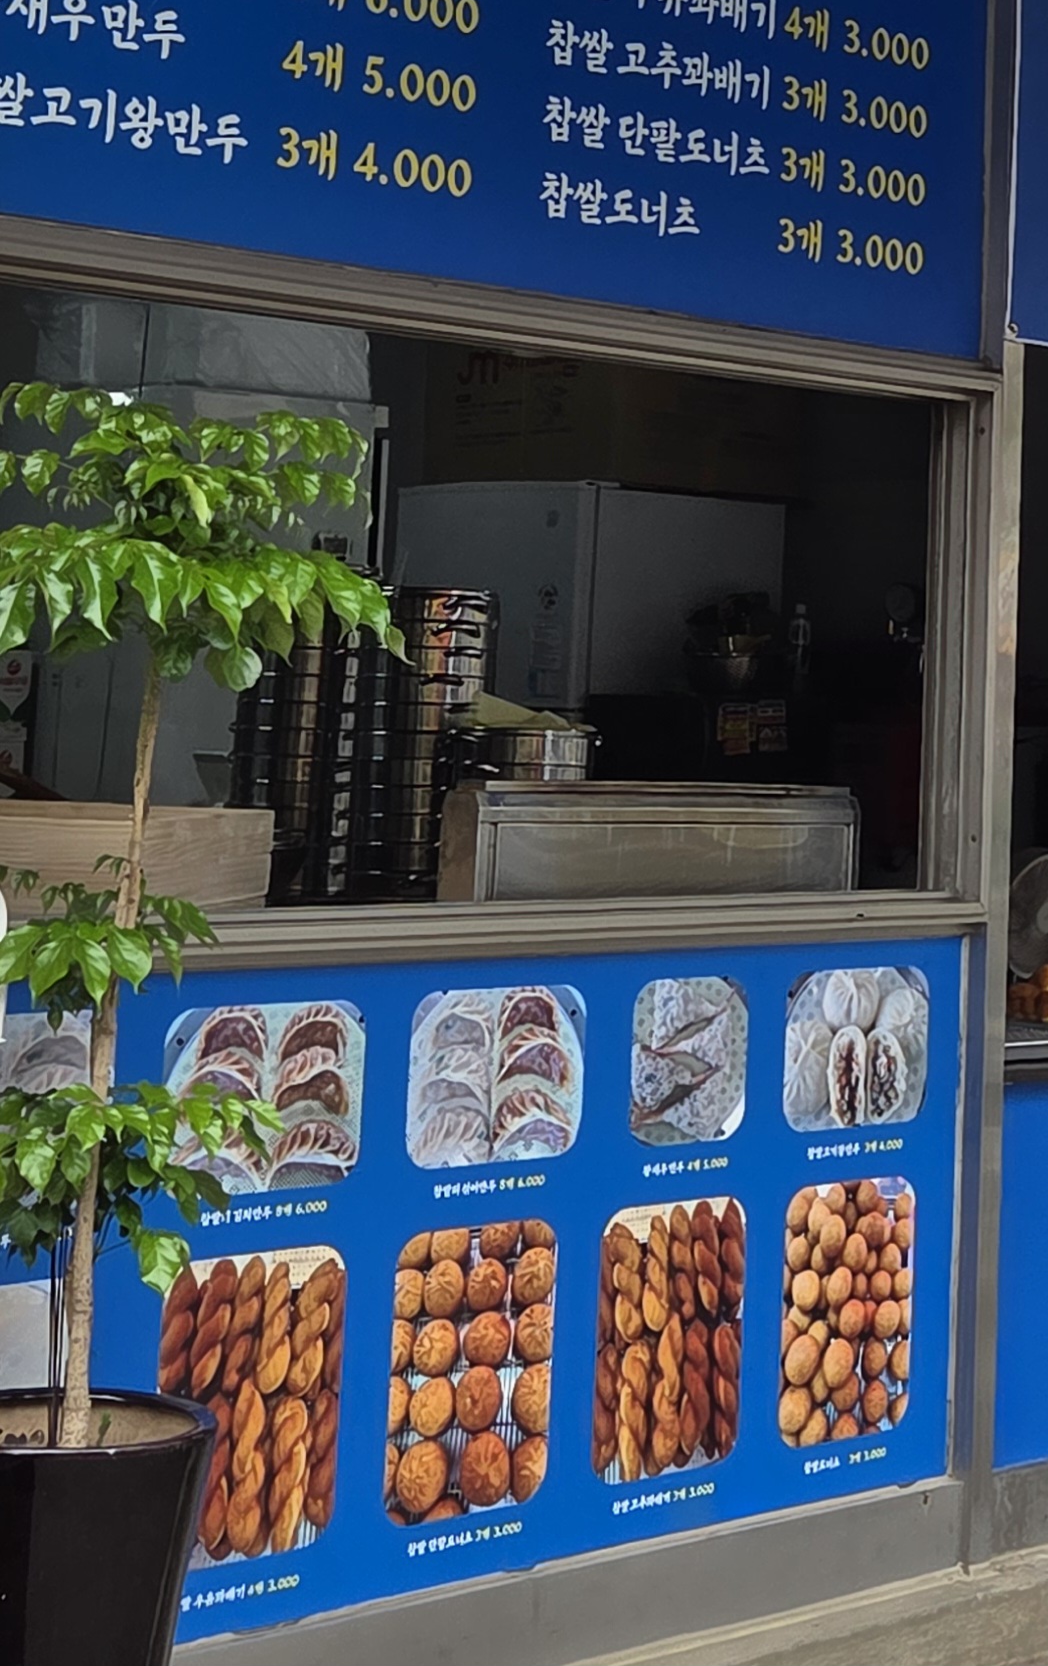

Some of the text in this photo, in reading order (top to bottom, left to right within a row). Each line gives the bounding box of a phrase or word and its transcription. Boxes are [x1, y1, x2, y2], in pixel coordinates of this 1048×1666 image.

[784, 6, 830, 52] 4개
[843, 19, 929, 70] 3.000
[281, 40, 344, 92] 4개
[362, 55, 477, 112] 5.000
[782, 75, 827, 122] 3개
[841, 89, 927, 138] 3.000
[276, 126, 338, 181] 3개
[353, 142, 472, 198] 4.000
[542, 95, 926, 206] 찹쌀 단팥도너츠 3개 3.000
[539, 172, 924, 275] 찹쌀도너츠 3개 3.000
